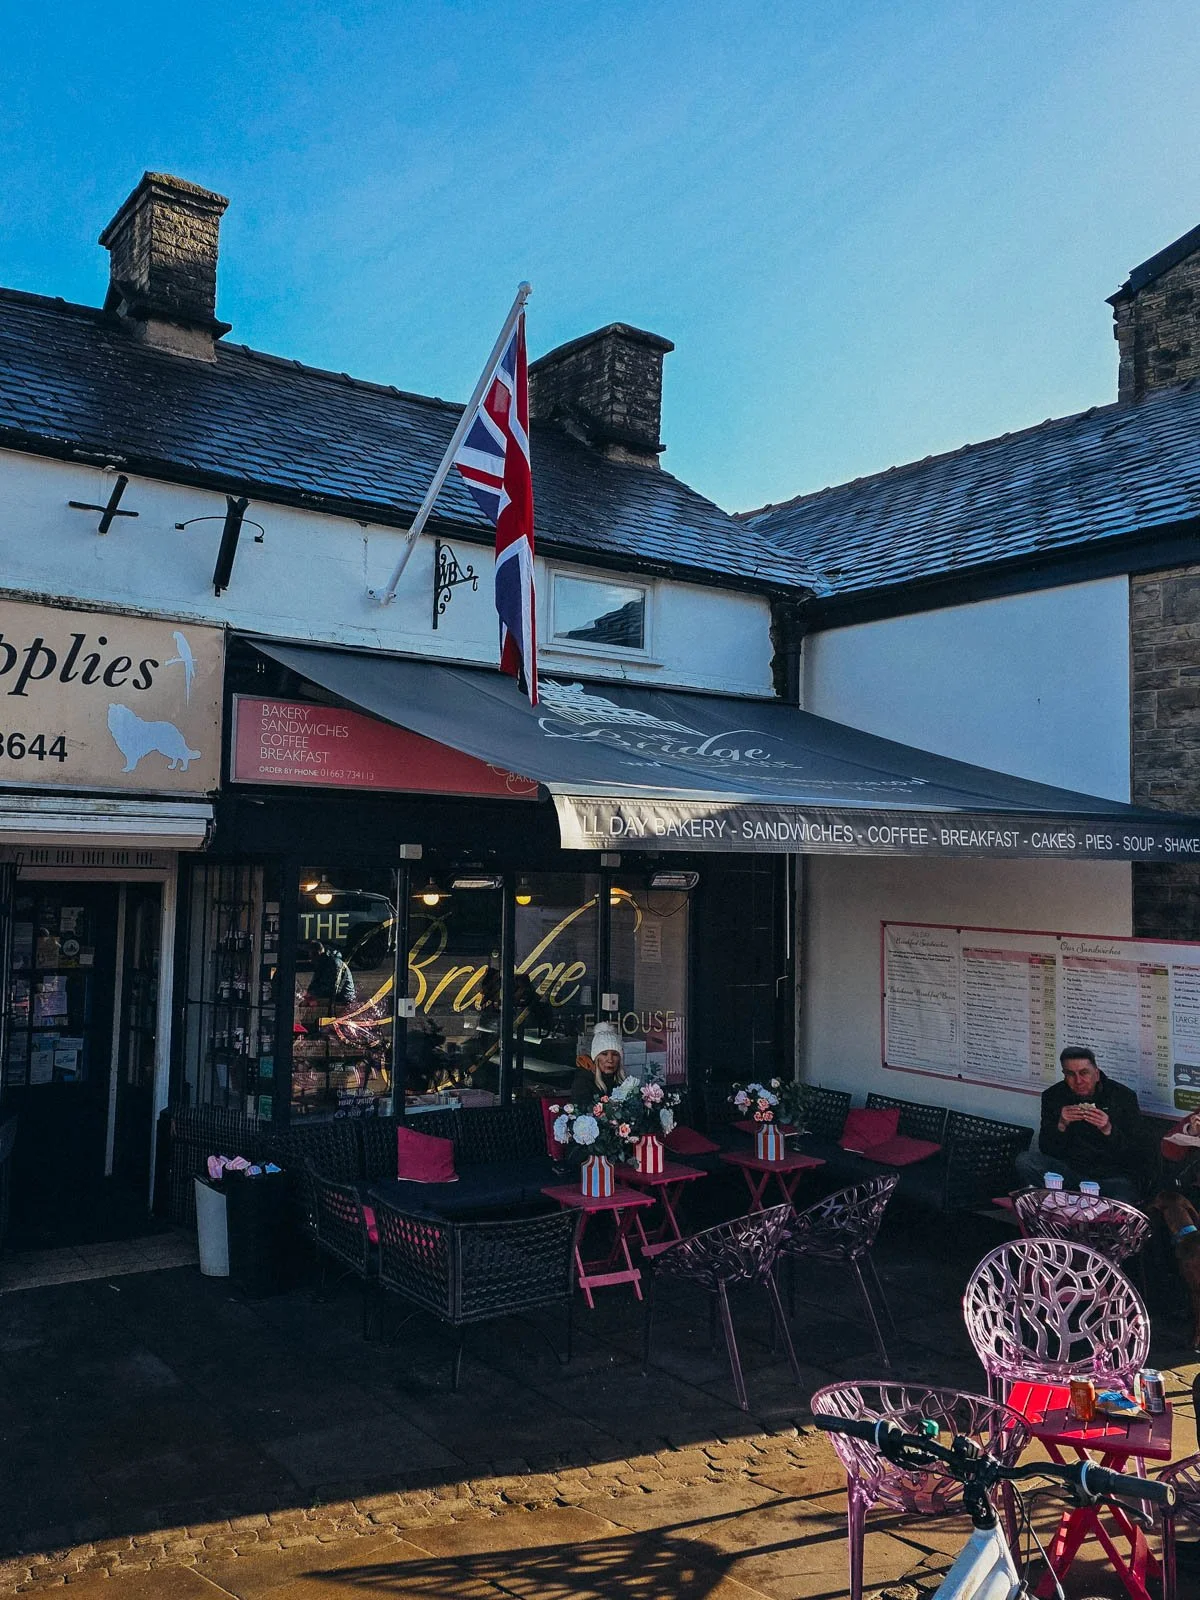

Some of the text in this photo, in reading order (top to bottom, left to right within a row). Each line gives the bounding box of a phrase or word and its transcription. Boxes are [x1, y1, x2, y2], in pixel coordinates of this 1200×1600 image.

[262, 703, 311, 720] BAKERY
[261, 718, 349, 738] SANDWICHES
[0, 732, 68, 763] 644
[260, 732, 309, 749] COFFEE
[537, 718, 784, 769] Bridge
[260, 746, 330, 764] BREAKFAST
[258, 764, 283, 774] ORDER
[284, 767, 293, 775] BY
[320, 768, 345, 778] 01663
[610, 815, 648, 836] DAY
[655, 817, 727, 838] BAKERY
[742, 820, 854, 843] SANDWICHES
[867, 825, 929, 845] COFFEE
[940, 829, 1020, 848] BREAKFAST
[1031, 832, 1076, 849] CAKES
[1085, 834, 1113, 850] PIES
[1122, 835, 1155, 852] SOUP
[1164, 837, 1200, 853] SHAKE
[300, 913, 350, 940] THE
[1060, 941, 1121, 954] Our Sandwiches
[1175, 1015, 1199, 1025] LARGE
